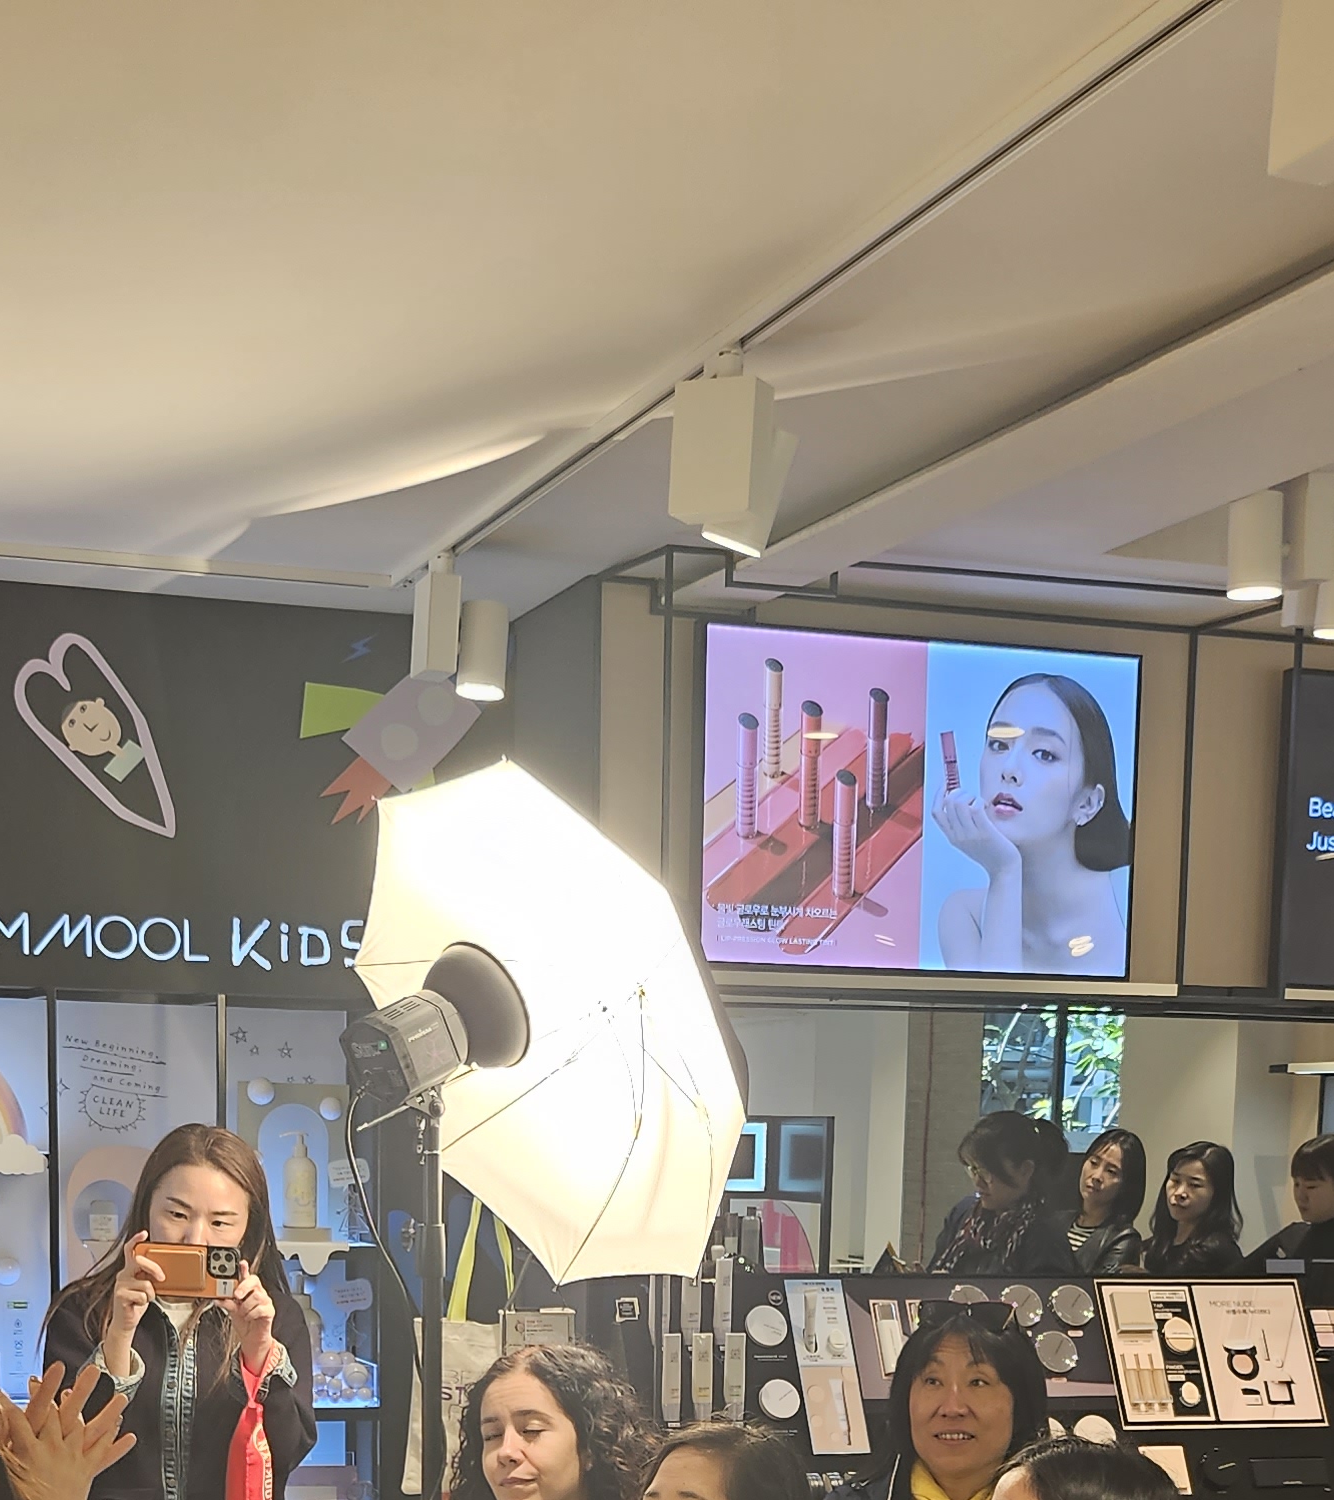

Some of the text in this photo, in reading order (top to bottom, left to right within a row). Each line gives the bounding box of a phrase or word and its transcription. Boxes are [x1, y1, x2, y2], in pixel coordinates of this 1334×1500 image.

[65, 1035, 88, 1045] New
[93, 1075, 161, 1093] and Coming
[93, 1095, 135, 1109] CLEAN
[99, 1106, 126, 1118] LIFE
